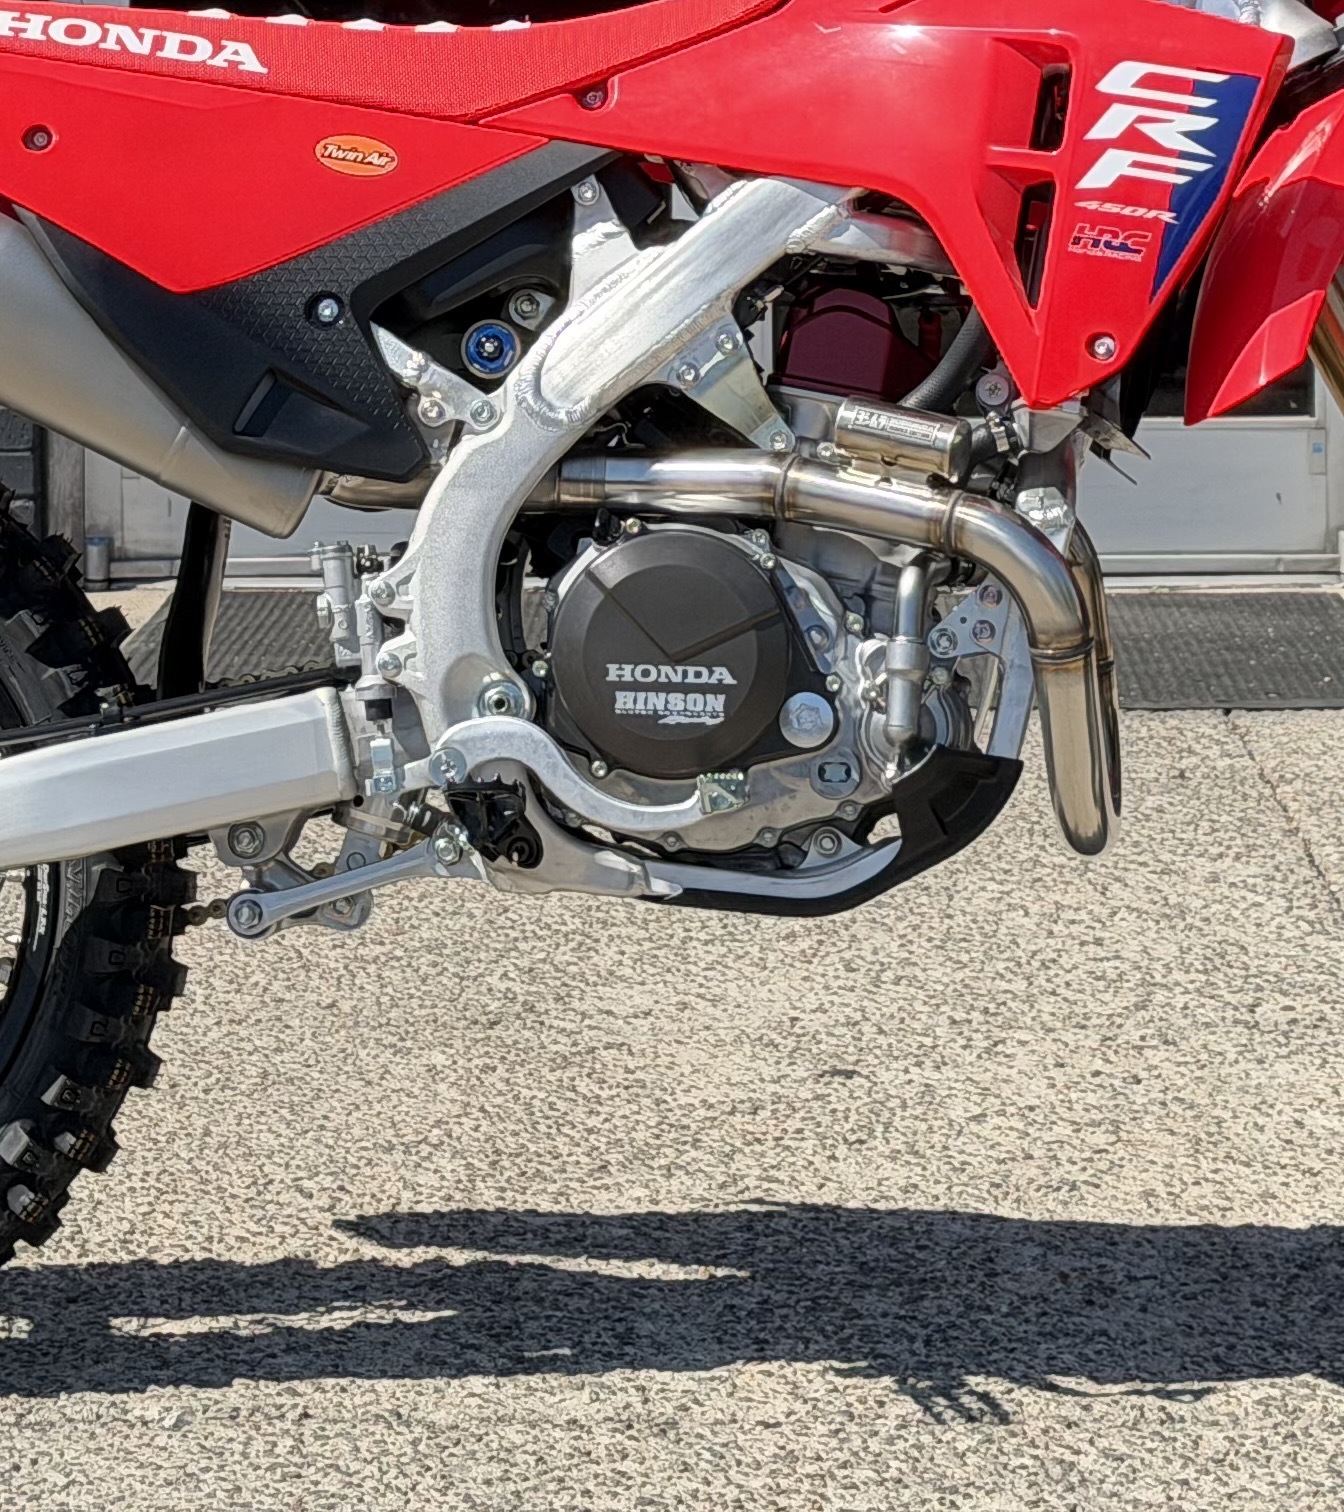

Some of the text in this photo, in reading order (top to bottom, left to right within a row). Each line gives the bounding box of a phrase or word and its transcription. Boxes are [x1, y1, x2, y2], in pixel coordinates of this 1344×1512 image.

[321, 143, 394, 167] Twin Air
[1073, 200, 1181, 225] 450R
[1067, 222, 1153, 256] HRC
[605, 663, 739, 685] HONDA
[614, 690, 727, 712] HINSON
